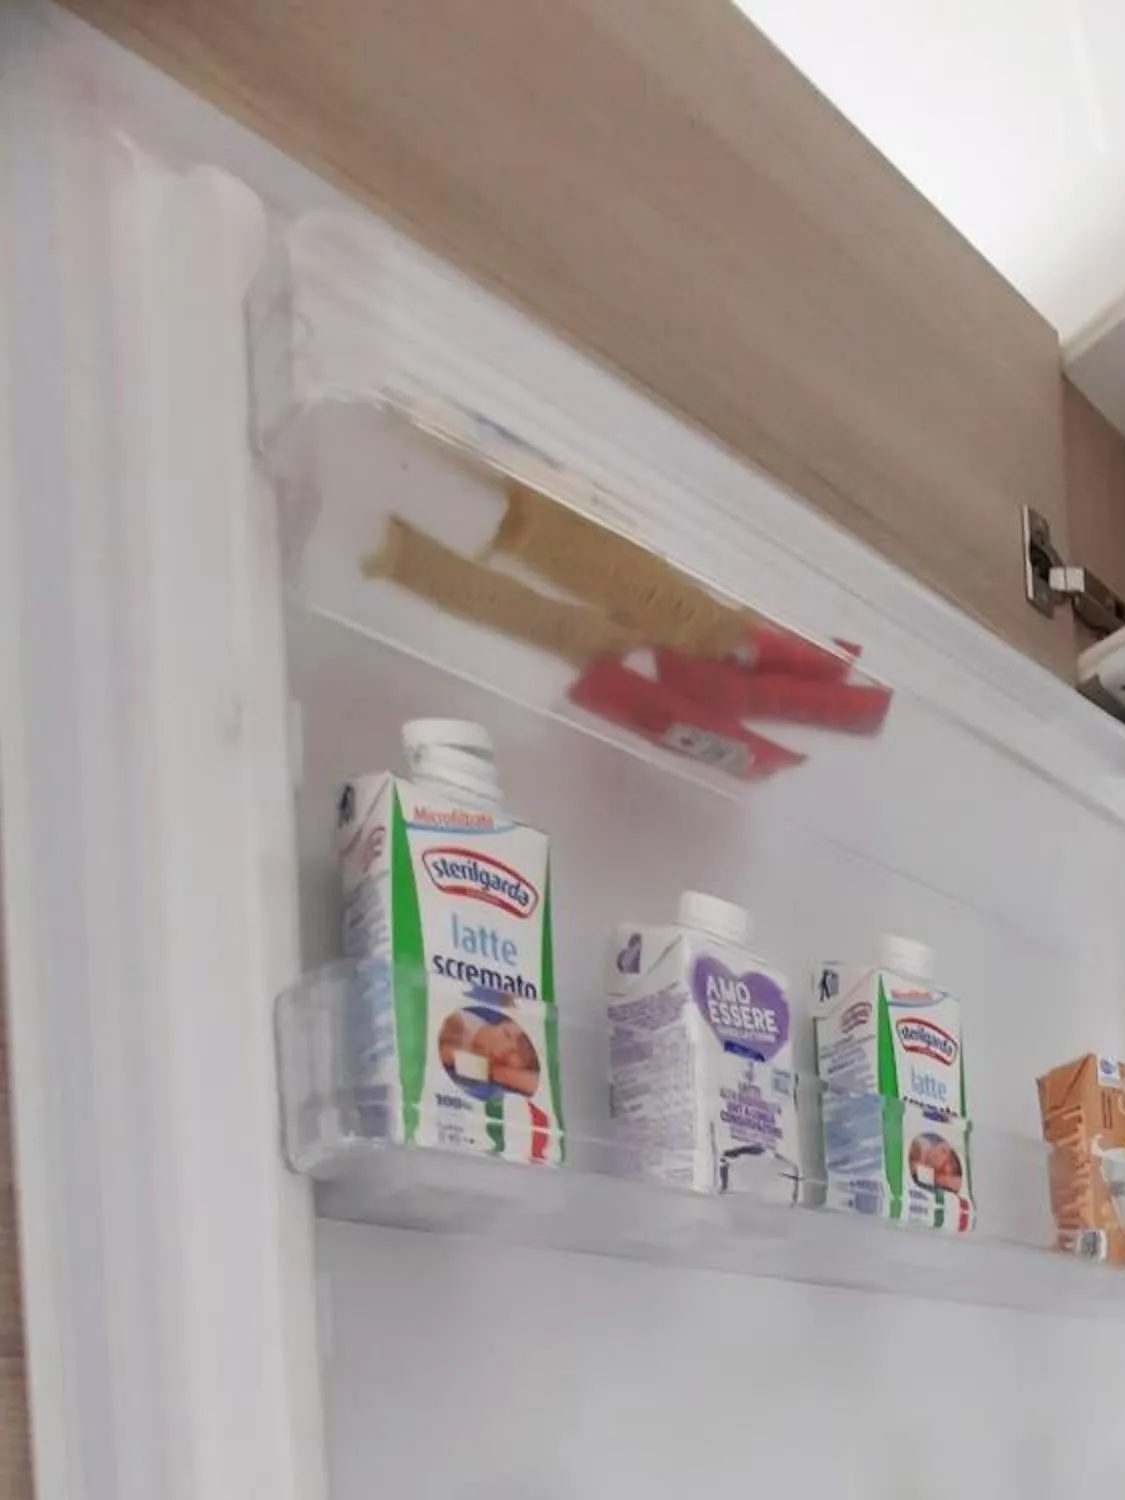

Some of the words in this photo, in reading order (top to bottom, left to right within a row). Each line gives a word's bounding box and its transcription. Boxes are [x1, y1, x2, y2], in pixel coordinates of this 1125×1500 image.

[431, 858, 530, 907] sterilgarda
[451, 911, 518, 967] latte
[706, 975, 751, 1005] AMO
[707, 1000, 779, 1034] ESSERE
[910, 1063, 948, 1103] latte
